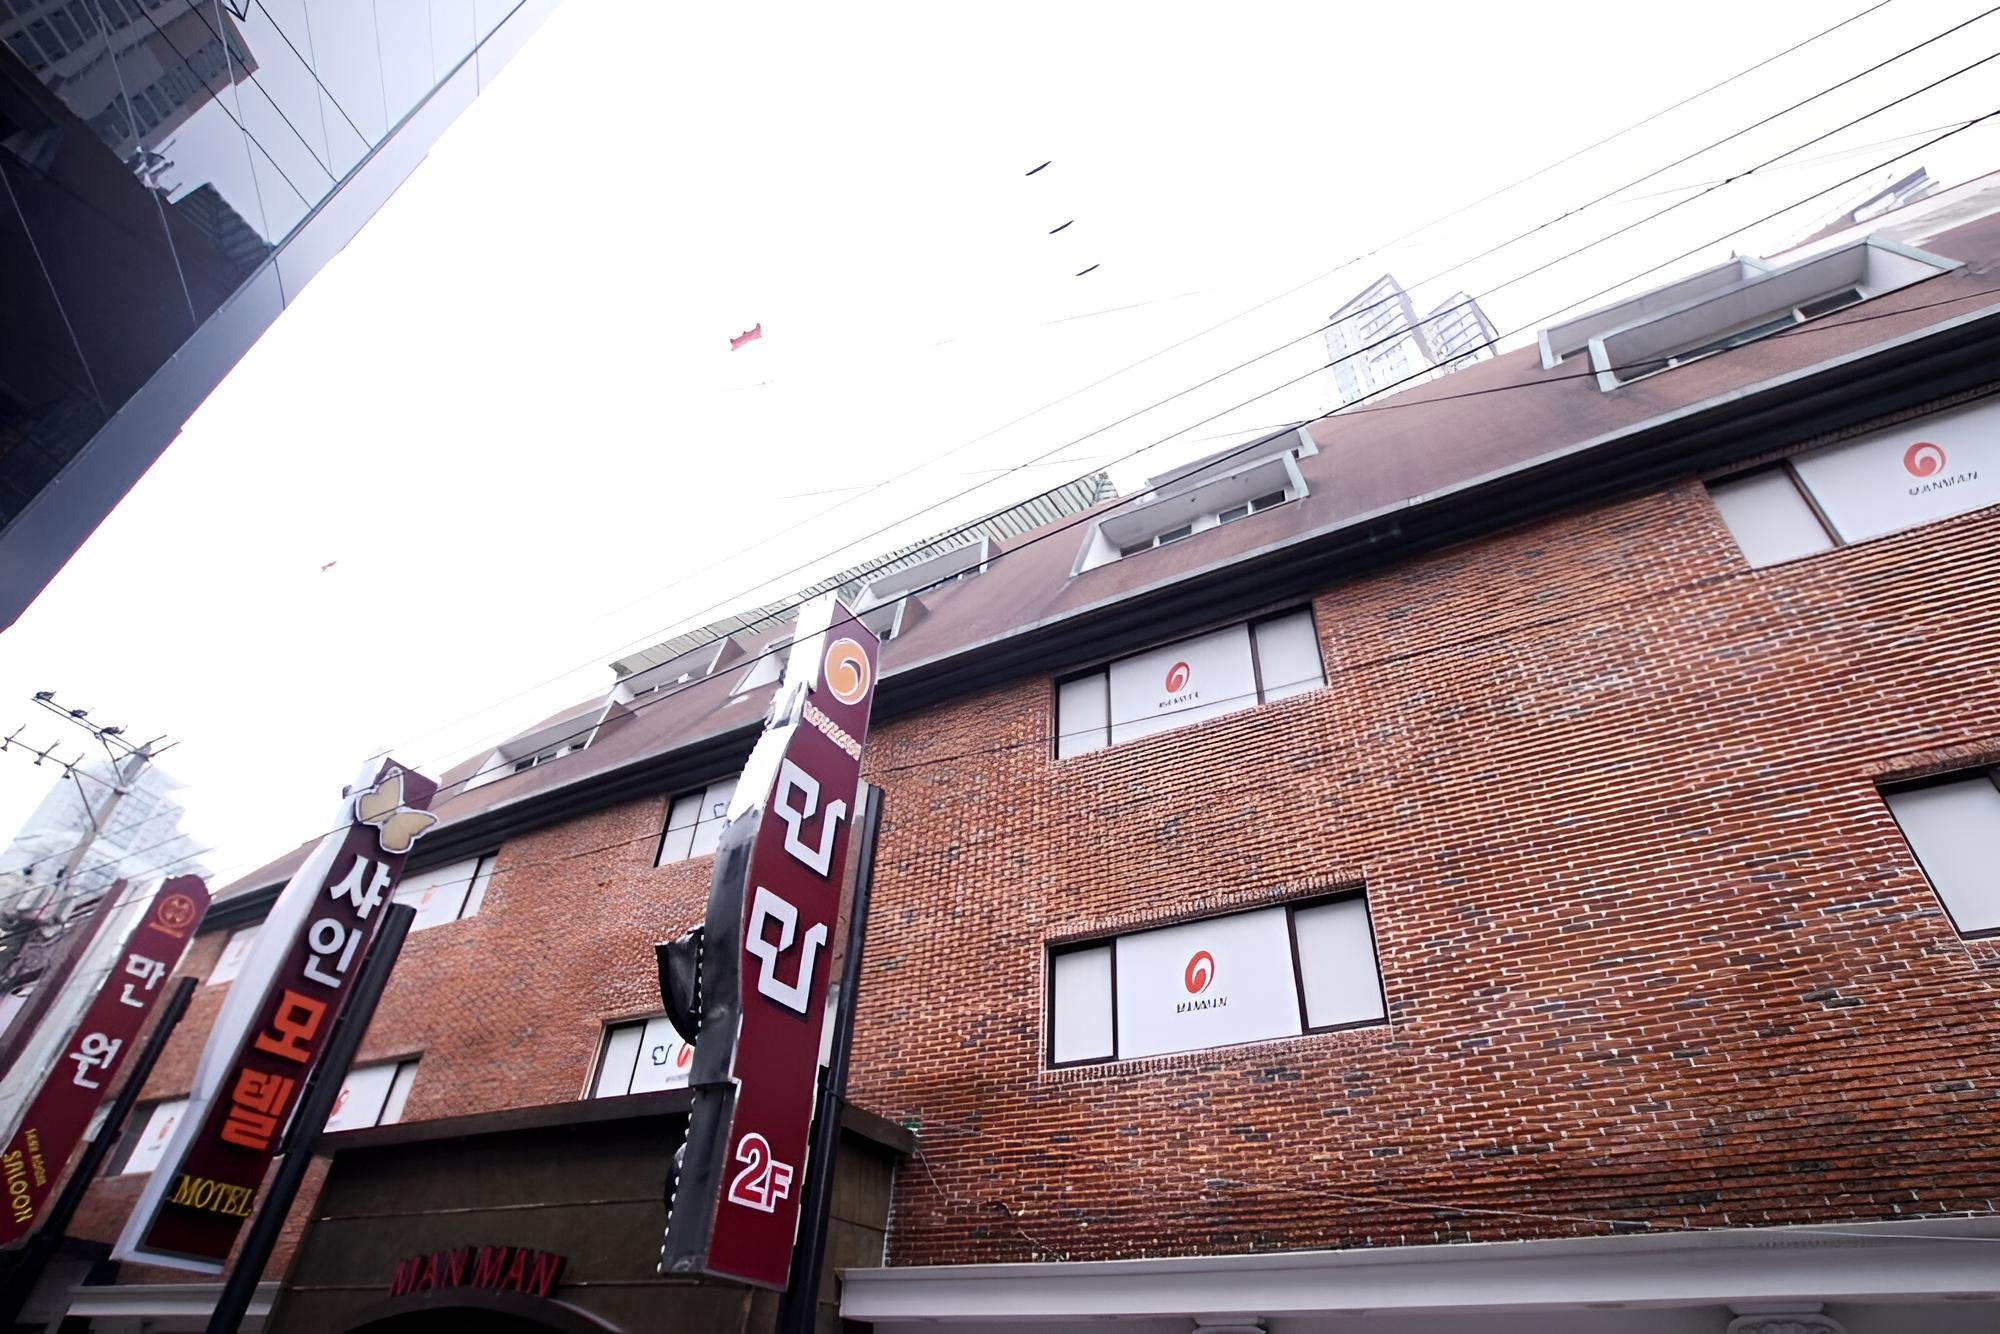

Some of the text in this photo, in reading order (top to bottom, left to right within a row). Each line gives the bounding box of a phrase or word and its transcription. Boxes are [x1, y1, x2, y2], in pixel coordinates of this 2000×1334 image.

[220, 854, 392, 1150] 샤인 모텔
[170, 1174, 254, 1218] MOTEL
[728, 1132, 794, 1214] 2F
[388, 1246, 561, 1298] MAN MAN
